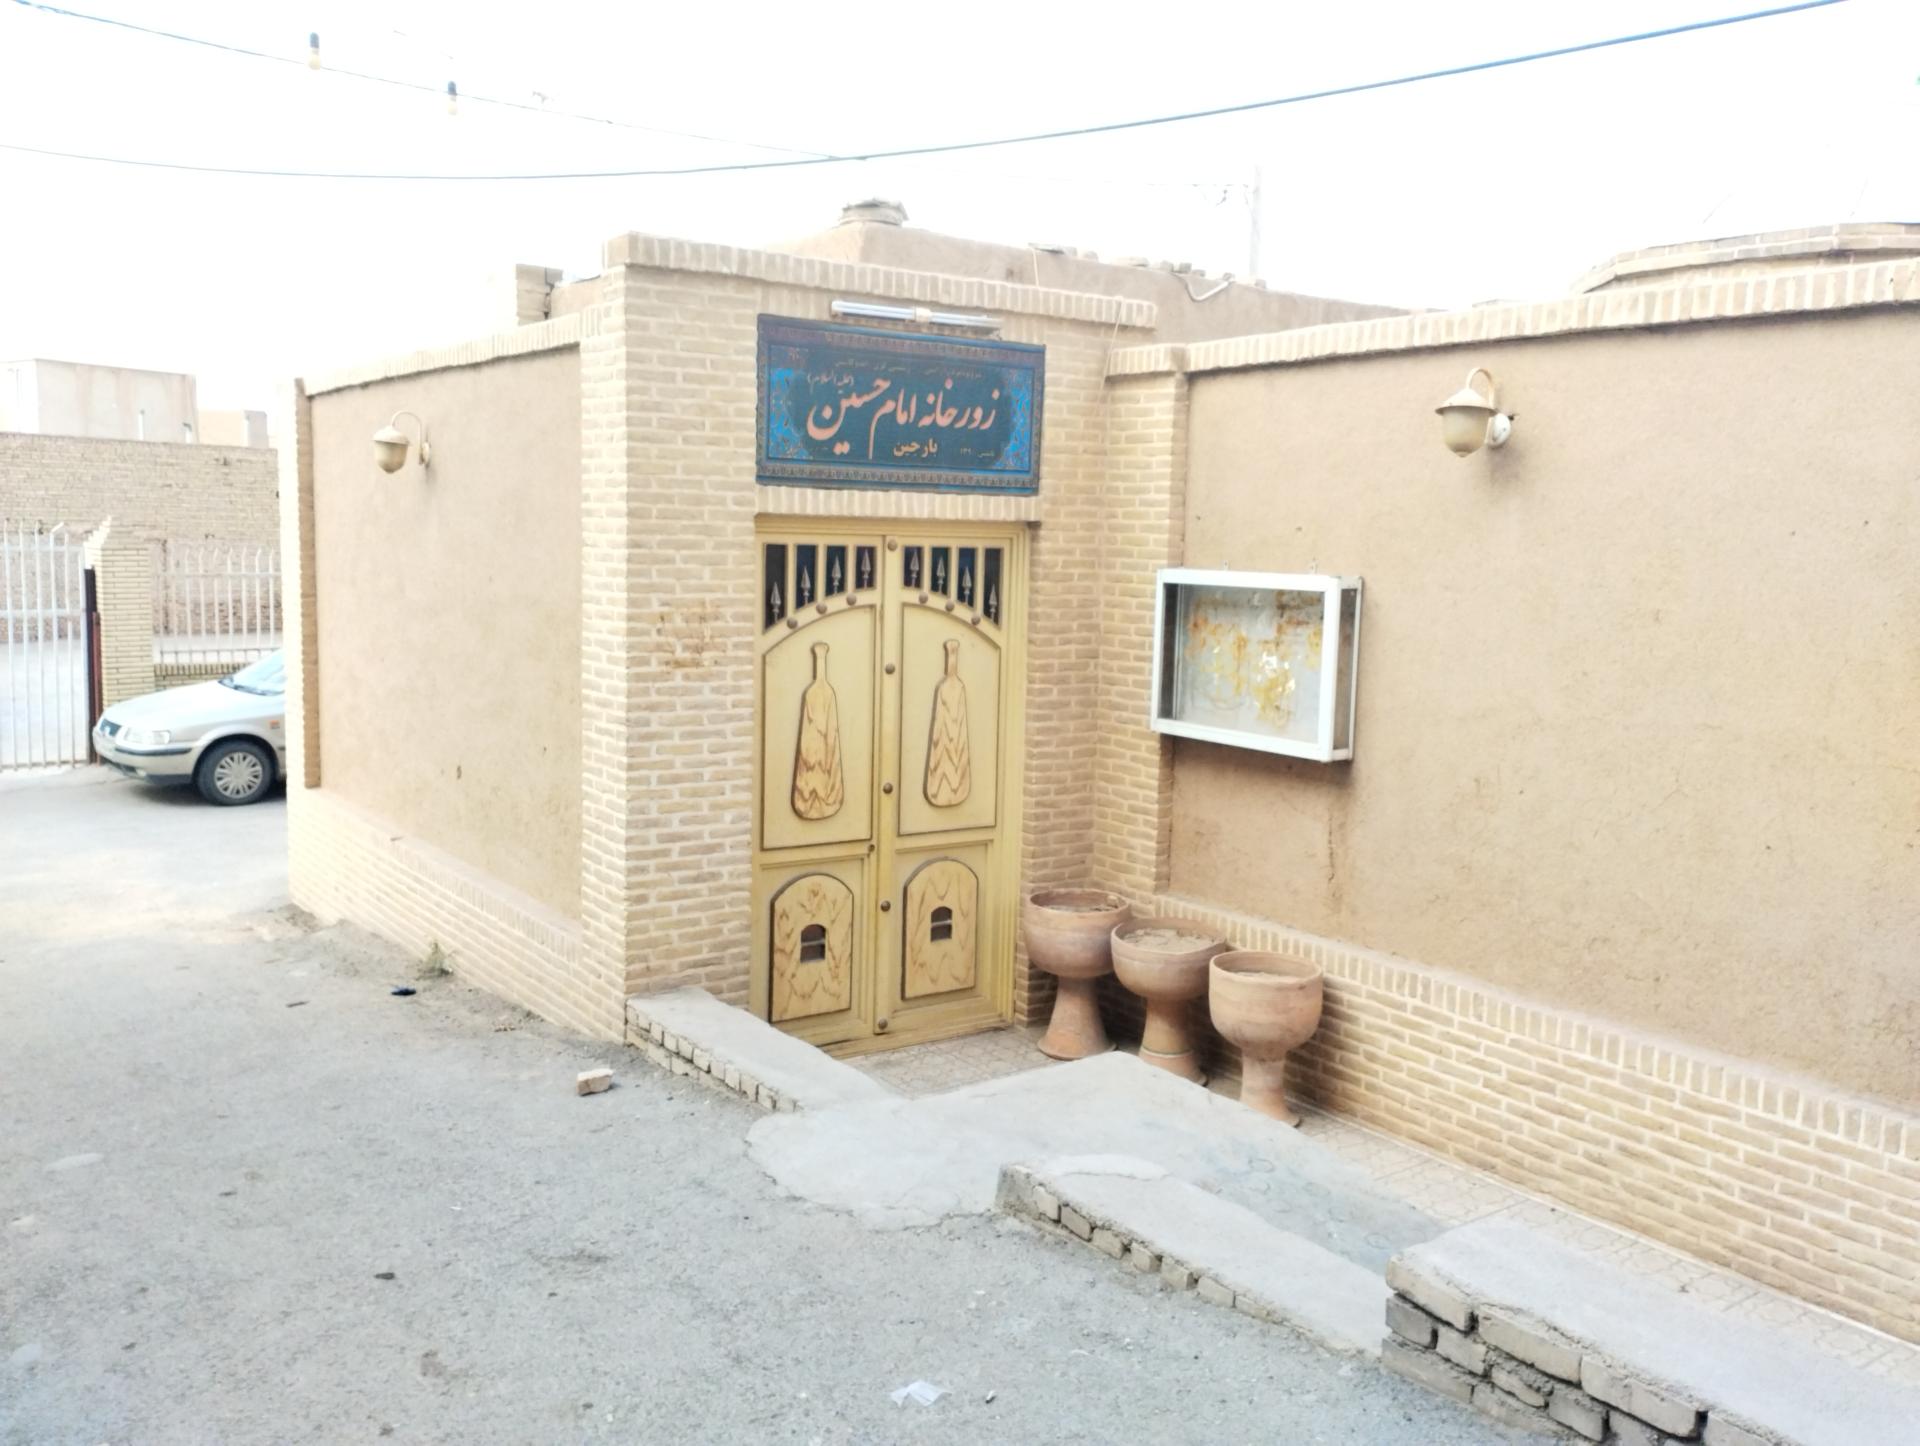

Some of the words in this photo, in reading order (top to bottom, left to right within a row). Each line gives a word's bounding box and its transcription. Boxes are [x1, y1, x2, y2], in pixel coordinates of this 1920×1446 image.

[806, 377, 891, 456] حسین
[867, 386, 918, 460] امام
[918, 377, 1000, 430] زورخانه
